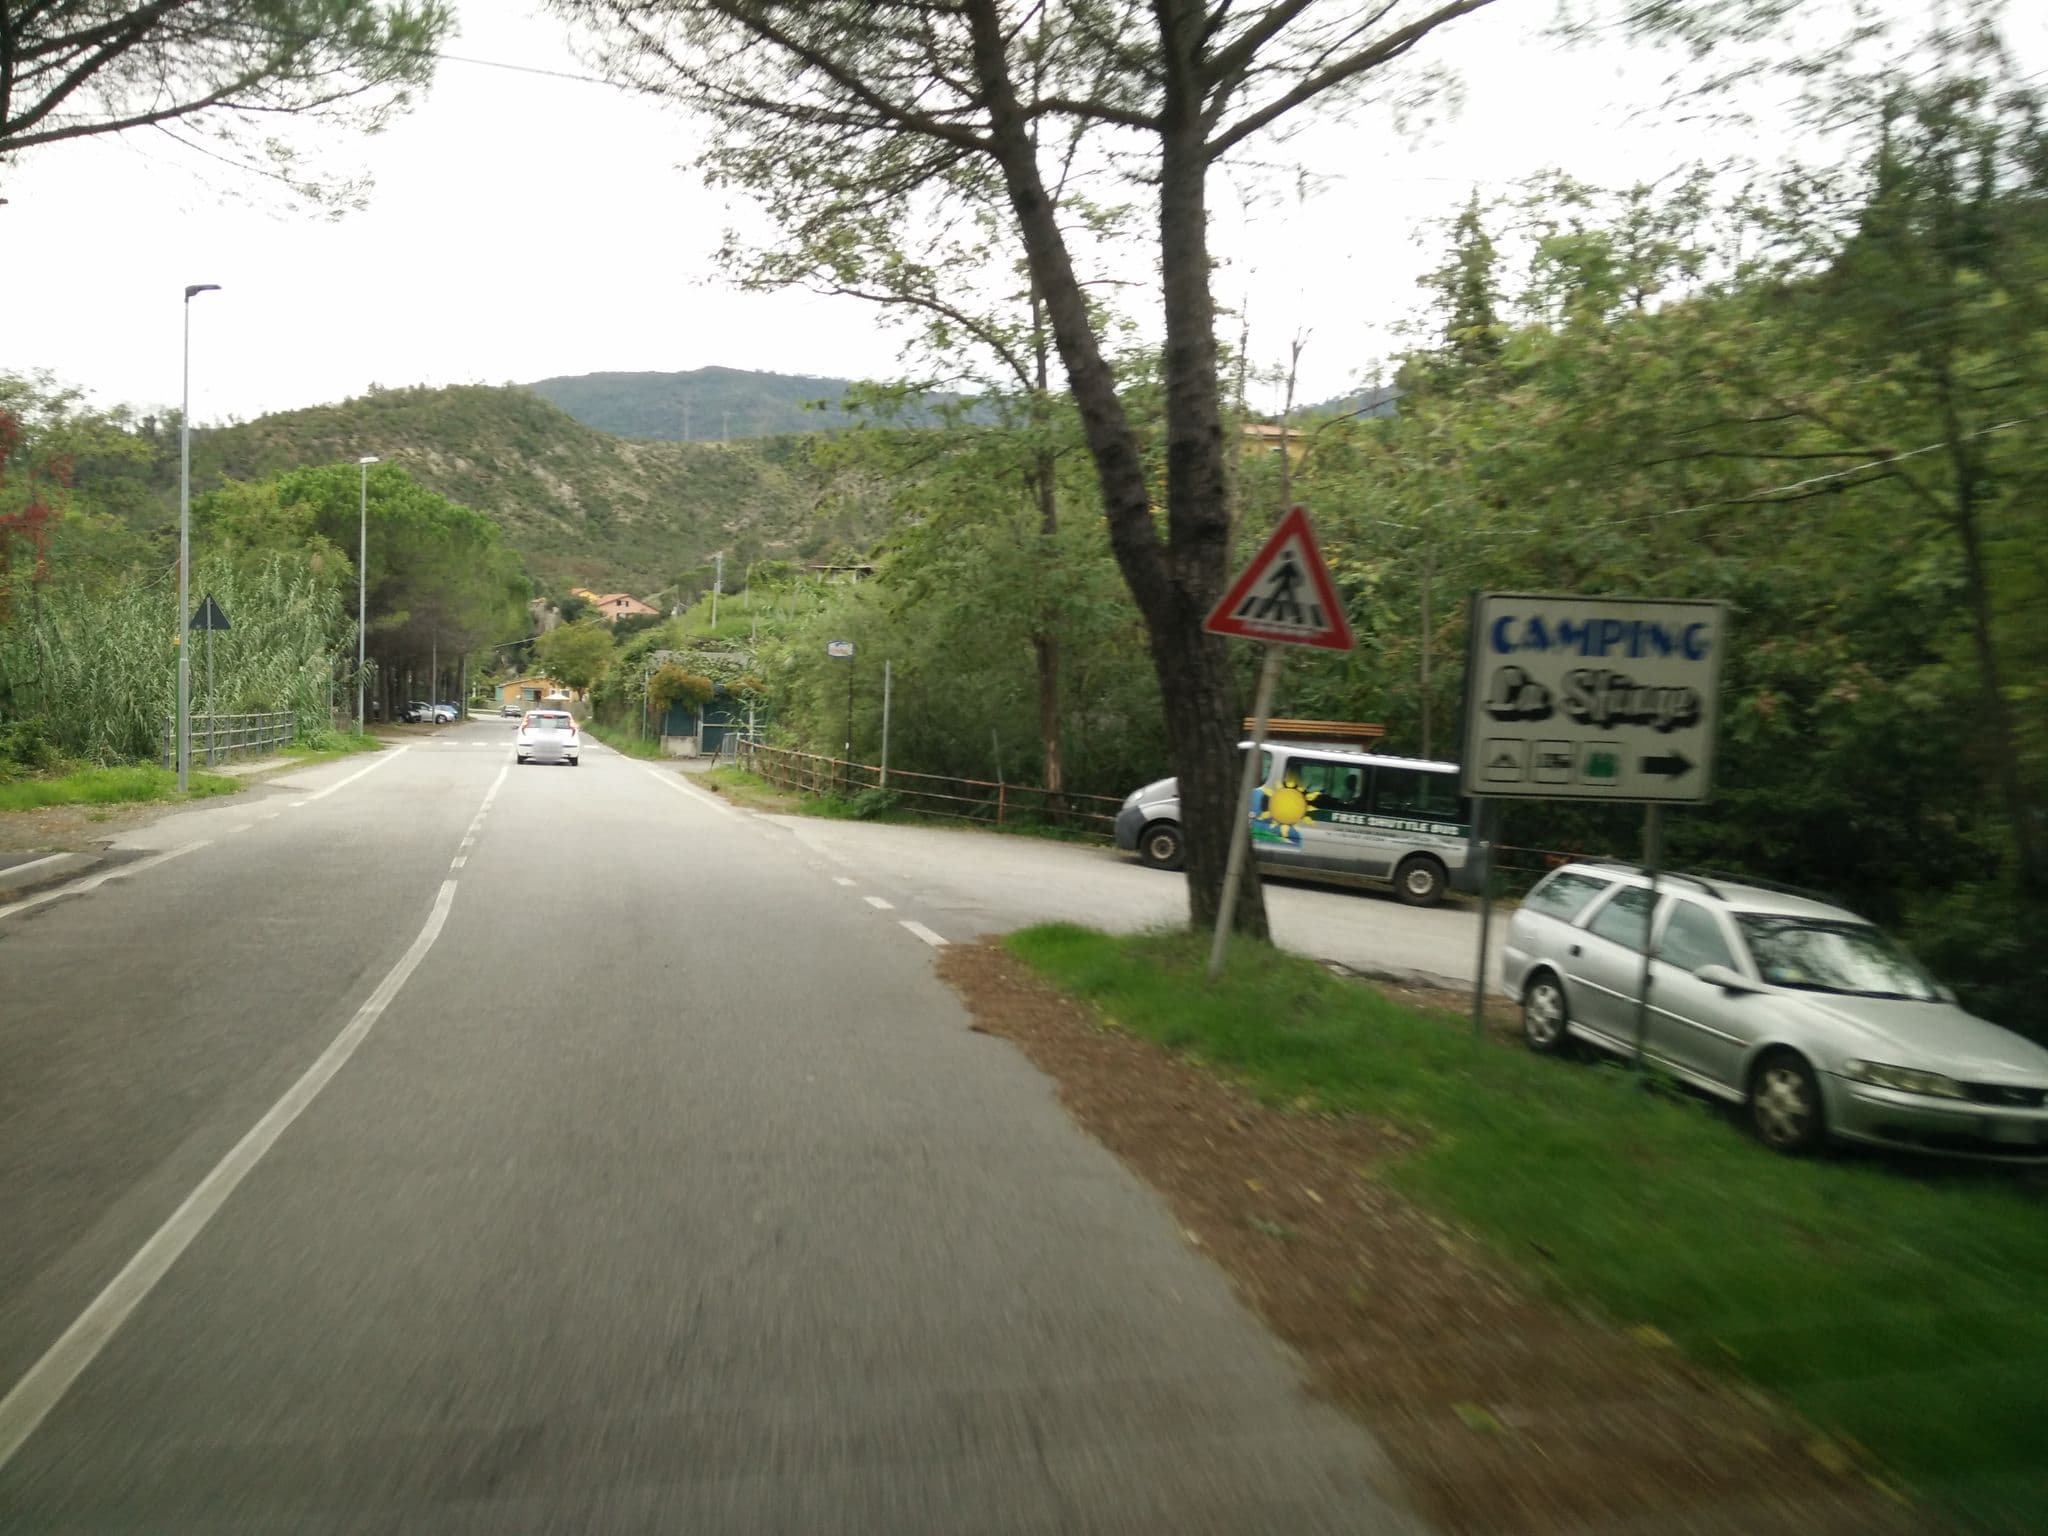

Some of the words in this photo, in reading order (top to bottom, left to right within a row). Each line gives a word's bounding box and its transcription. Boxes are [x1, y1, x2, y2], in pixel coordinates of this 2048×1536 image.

[1492, 616, 1708, 660] CAMPING
[1485, 664, 1555, 722] La
[1332, 812, 1366, 824] FREE
[1367, 817, 1430, 831] SHUTTLE
[1430, 823, 1459, 835] BUS
